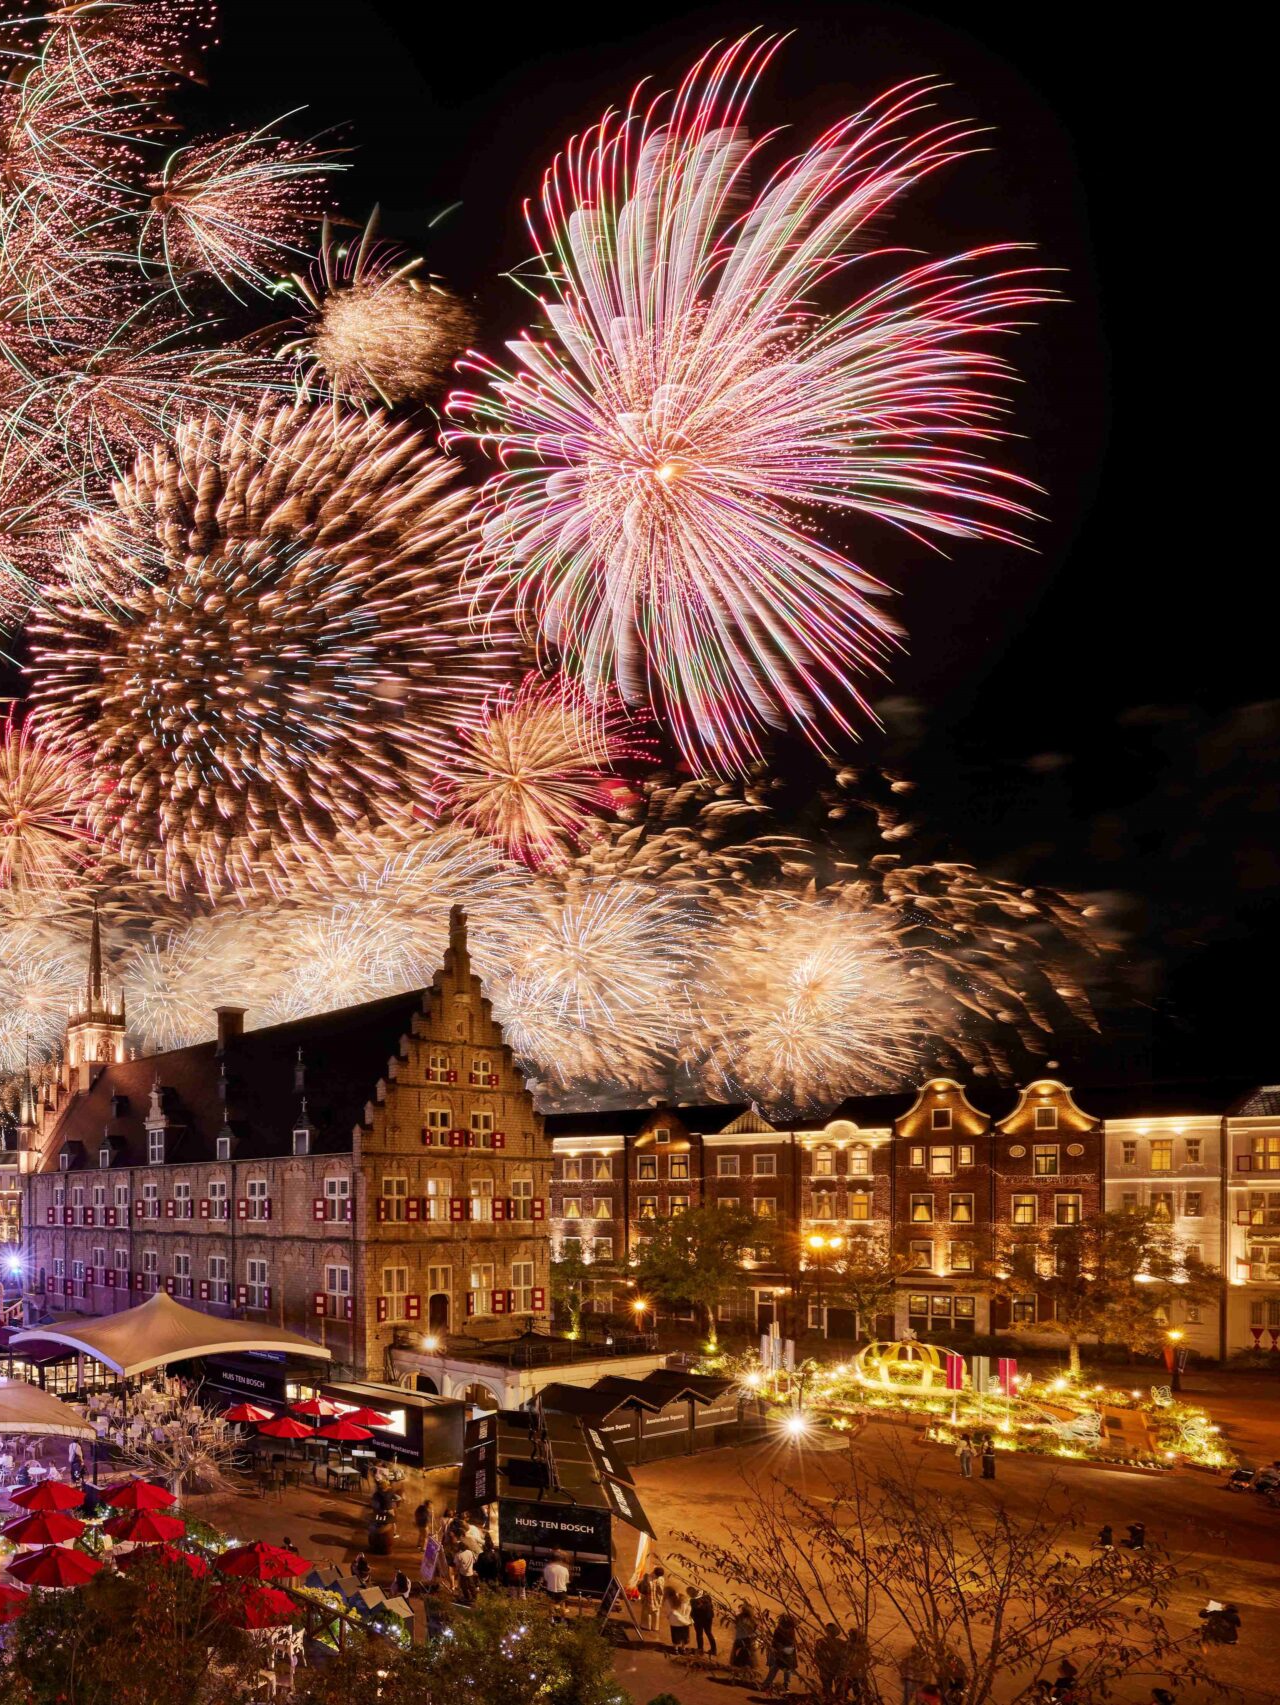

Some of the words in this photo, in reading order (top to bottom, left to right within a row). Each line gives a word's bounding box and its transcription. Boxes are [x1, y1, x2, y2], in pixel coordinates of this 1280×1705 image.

[222, 1371, 235, 1381] HUIS
[235, 1375, 246, 1384] TEN
[246, 1377, 265, 1388] BOSCH
[698, 1407, 721, 1416] Amsterdam
[645, 1416, 670, 1425] Amsterdam
[670, 1413, 685, 1422] Square
[615, 1423, 631, 1431] Square
[372, 1439, 391, 1449] Garden
[390, 1444, 419, 1457] Restaurant
[515, 1518, 538, 1527] HUIS
[540, 1520, 559, 1530] TEN
[560, 1523, 595, 1534] BOSCH
